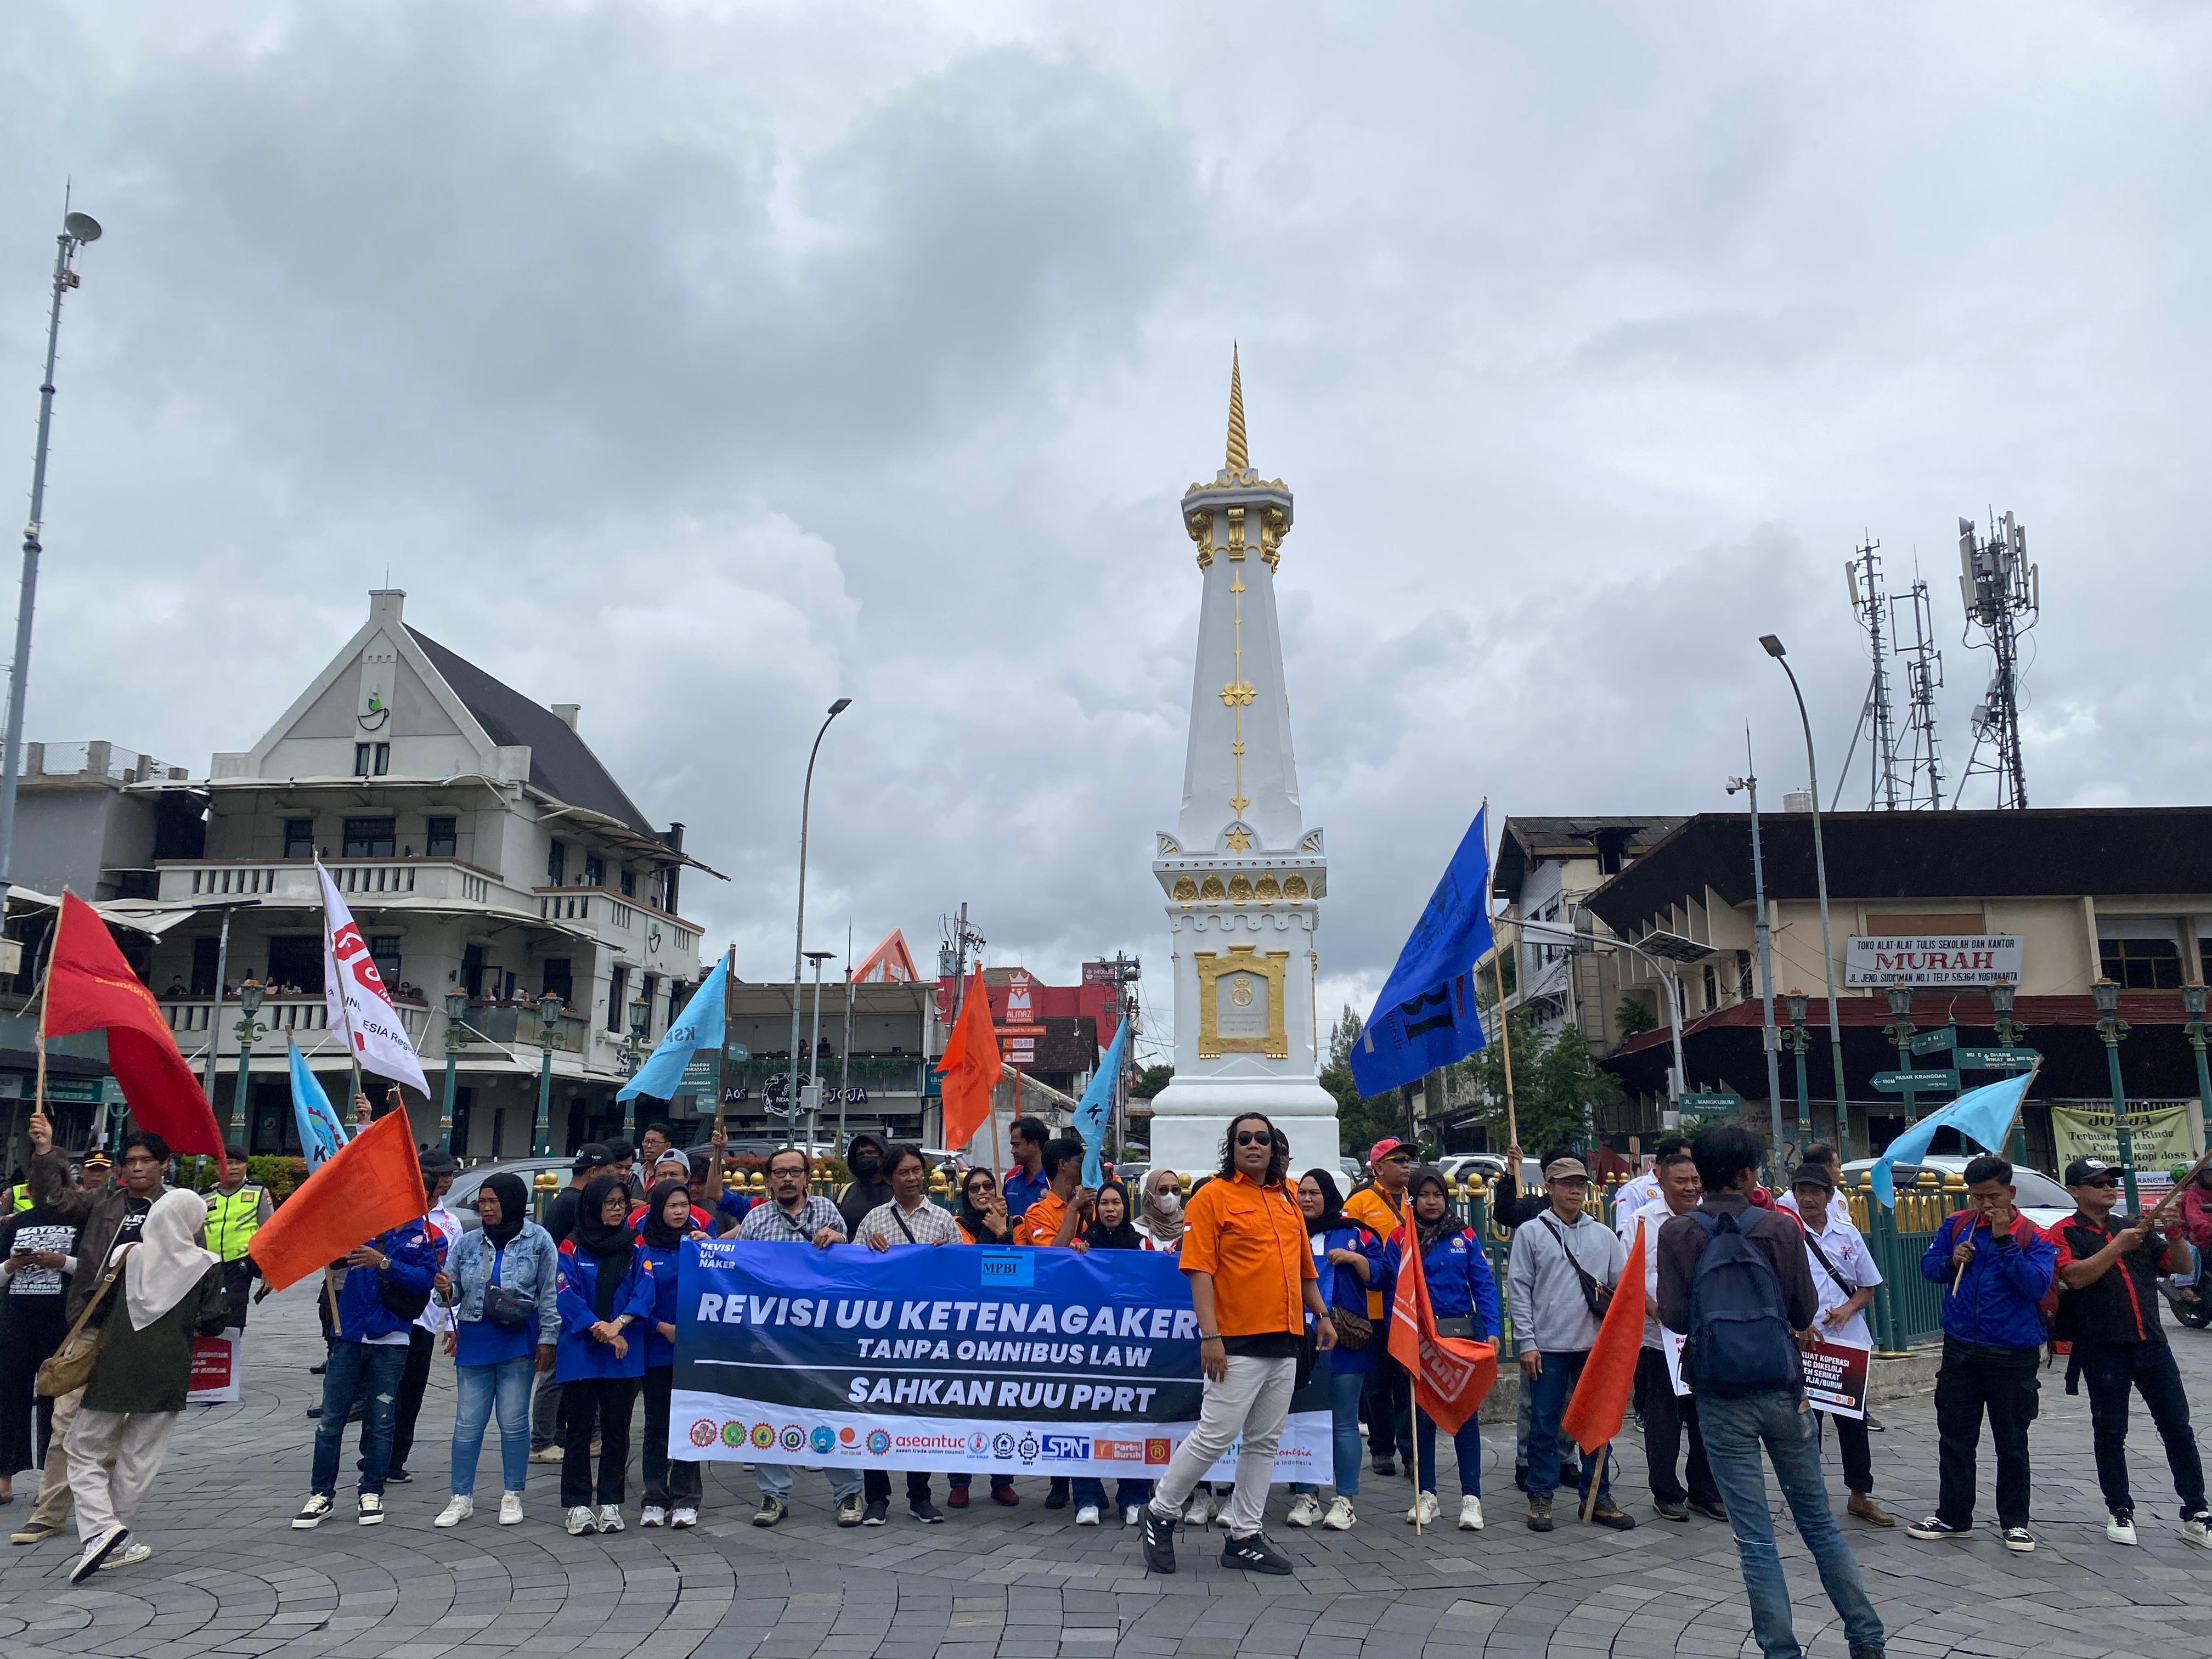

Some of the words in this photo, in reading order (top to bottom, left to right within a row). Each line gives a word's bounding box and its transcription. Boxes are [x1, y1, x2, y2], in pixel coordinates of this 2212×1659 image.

[1857, 941, 1874, 950] TOKO
[1877, 940, 1912, 950] ALAT-ALAT
[1917, 940, 1936, 949] TULIS
[1939, 940, 1968, 949] SEKOLAH
[1972, 940, 1985, 949] DAN
[1988, 940, 2015, 949] KANTOR
[1875, 952, 1995, 970] MURAH
[1849, 974, 1859, 983] JL.
[1861, 974, 1878, 983] JEND.
[1933, 973, 1950, 982] TELP.
[1952, 973, 1975, 981] 515364
[2068, 1131, 2111, 1141] Terbuat
[2141, 1130, 2174, 1139] Rindu
[2134, 1142, 2155, 1150] dan
[2134, 1152, 2157, 1161] Kopi
[2161, 1150, 2187, 1159] Joss
[700, 1242, 735, 1253] REVISI
[700, 1250, 715, 1260] UU
[698, 1259, 736, 1270] NAKER
[983, 1262, 1017, 1274] MPBI
[696, 1293, 830, 1329] REVISI
[835, 1299, 893, 1330] UU
[898, 1301, 1203, 1340] KETENAGAKER
[857, 1338, 950, 1361] TANPA
[956, 1340, 1086, 1365] OMNIBUS
[1090, 1345, 1153, 1368] LAW
[1819, 1355, 1850, 1367] KOPERASI
[1813, 1361, 1843, 1374] DIKELOLA
[1814, 1369, 1840, 1381] SERIKAT
[848, 1376, 995, 1407] SAHKAN
[997, 1381, 1067, 1409] RUU
[1069, 1386, 1157, 1413] PPRT
[895, 1435, 966, 1448] aseantuc
[1043, 1437, 1089, 1458] SPN
[1114, 1443, 1141, 1452] Partai
[1114, 1451, 1141, 1459] Buruh
